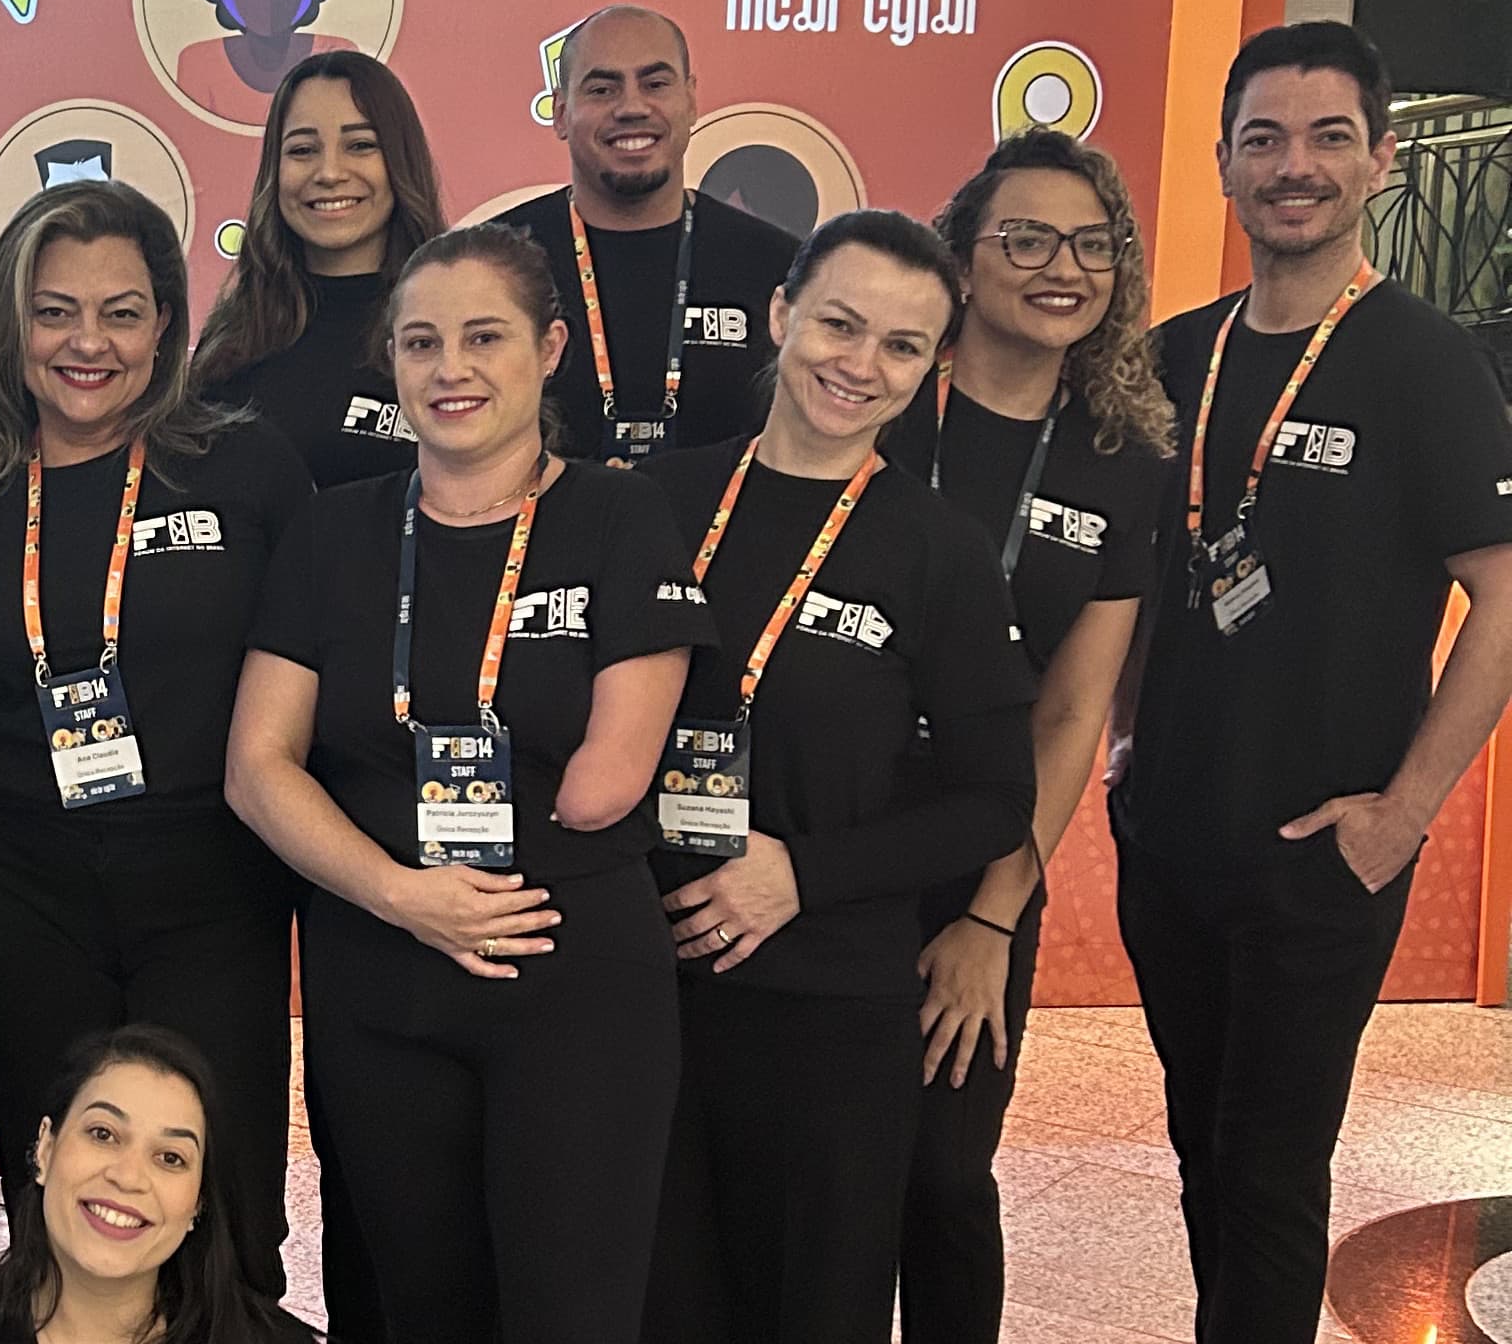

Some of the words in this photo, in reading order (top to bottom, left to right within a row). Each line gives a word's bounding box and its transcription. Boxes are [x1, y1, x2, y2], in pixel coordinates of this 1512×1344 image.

[73, 706, 97, 722] STAFF
[692, 757, 717, 769] STAFF
[450, 765, 477, 778] STAFF
